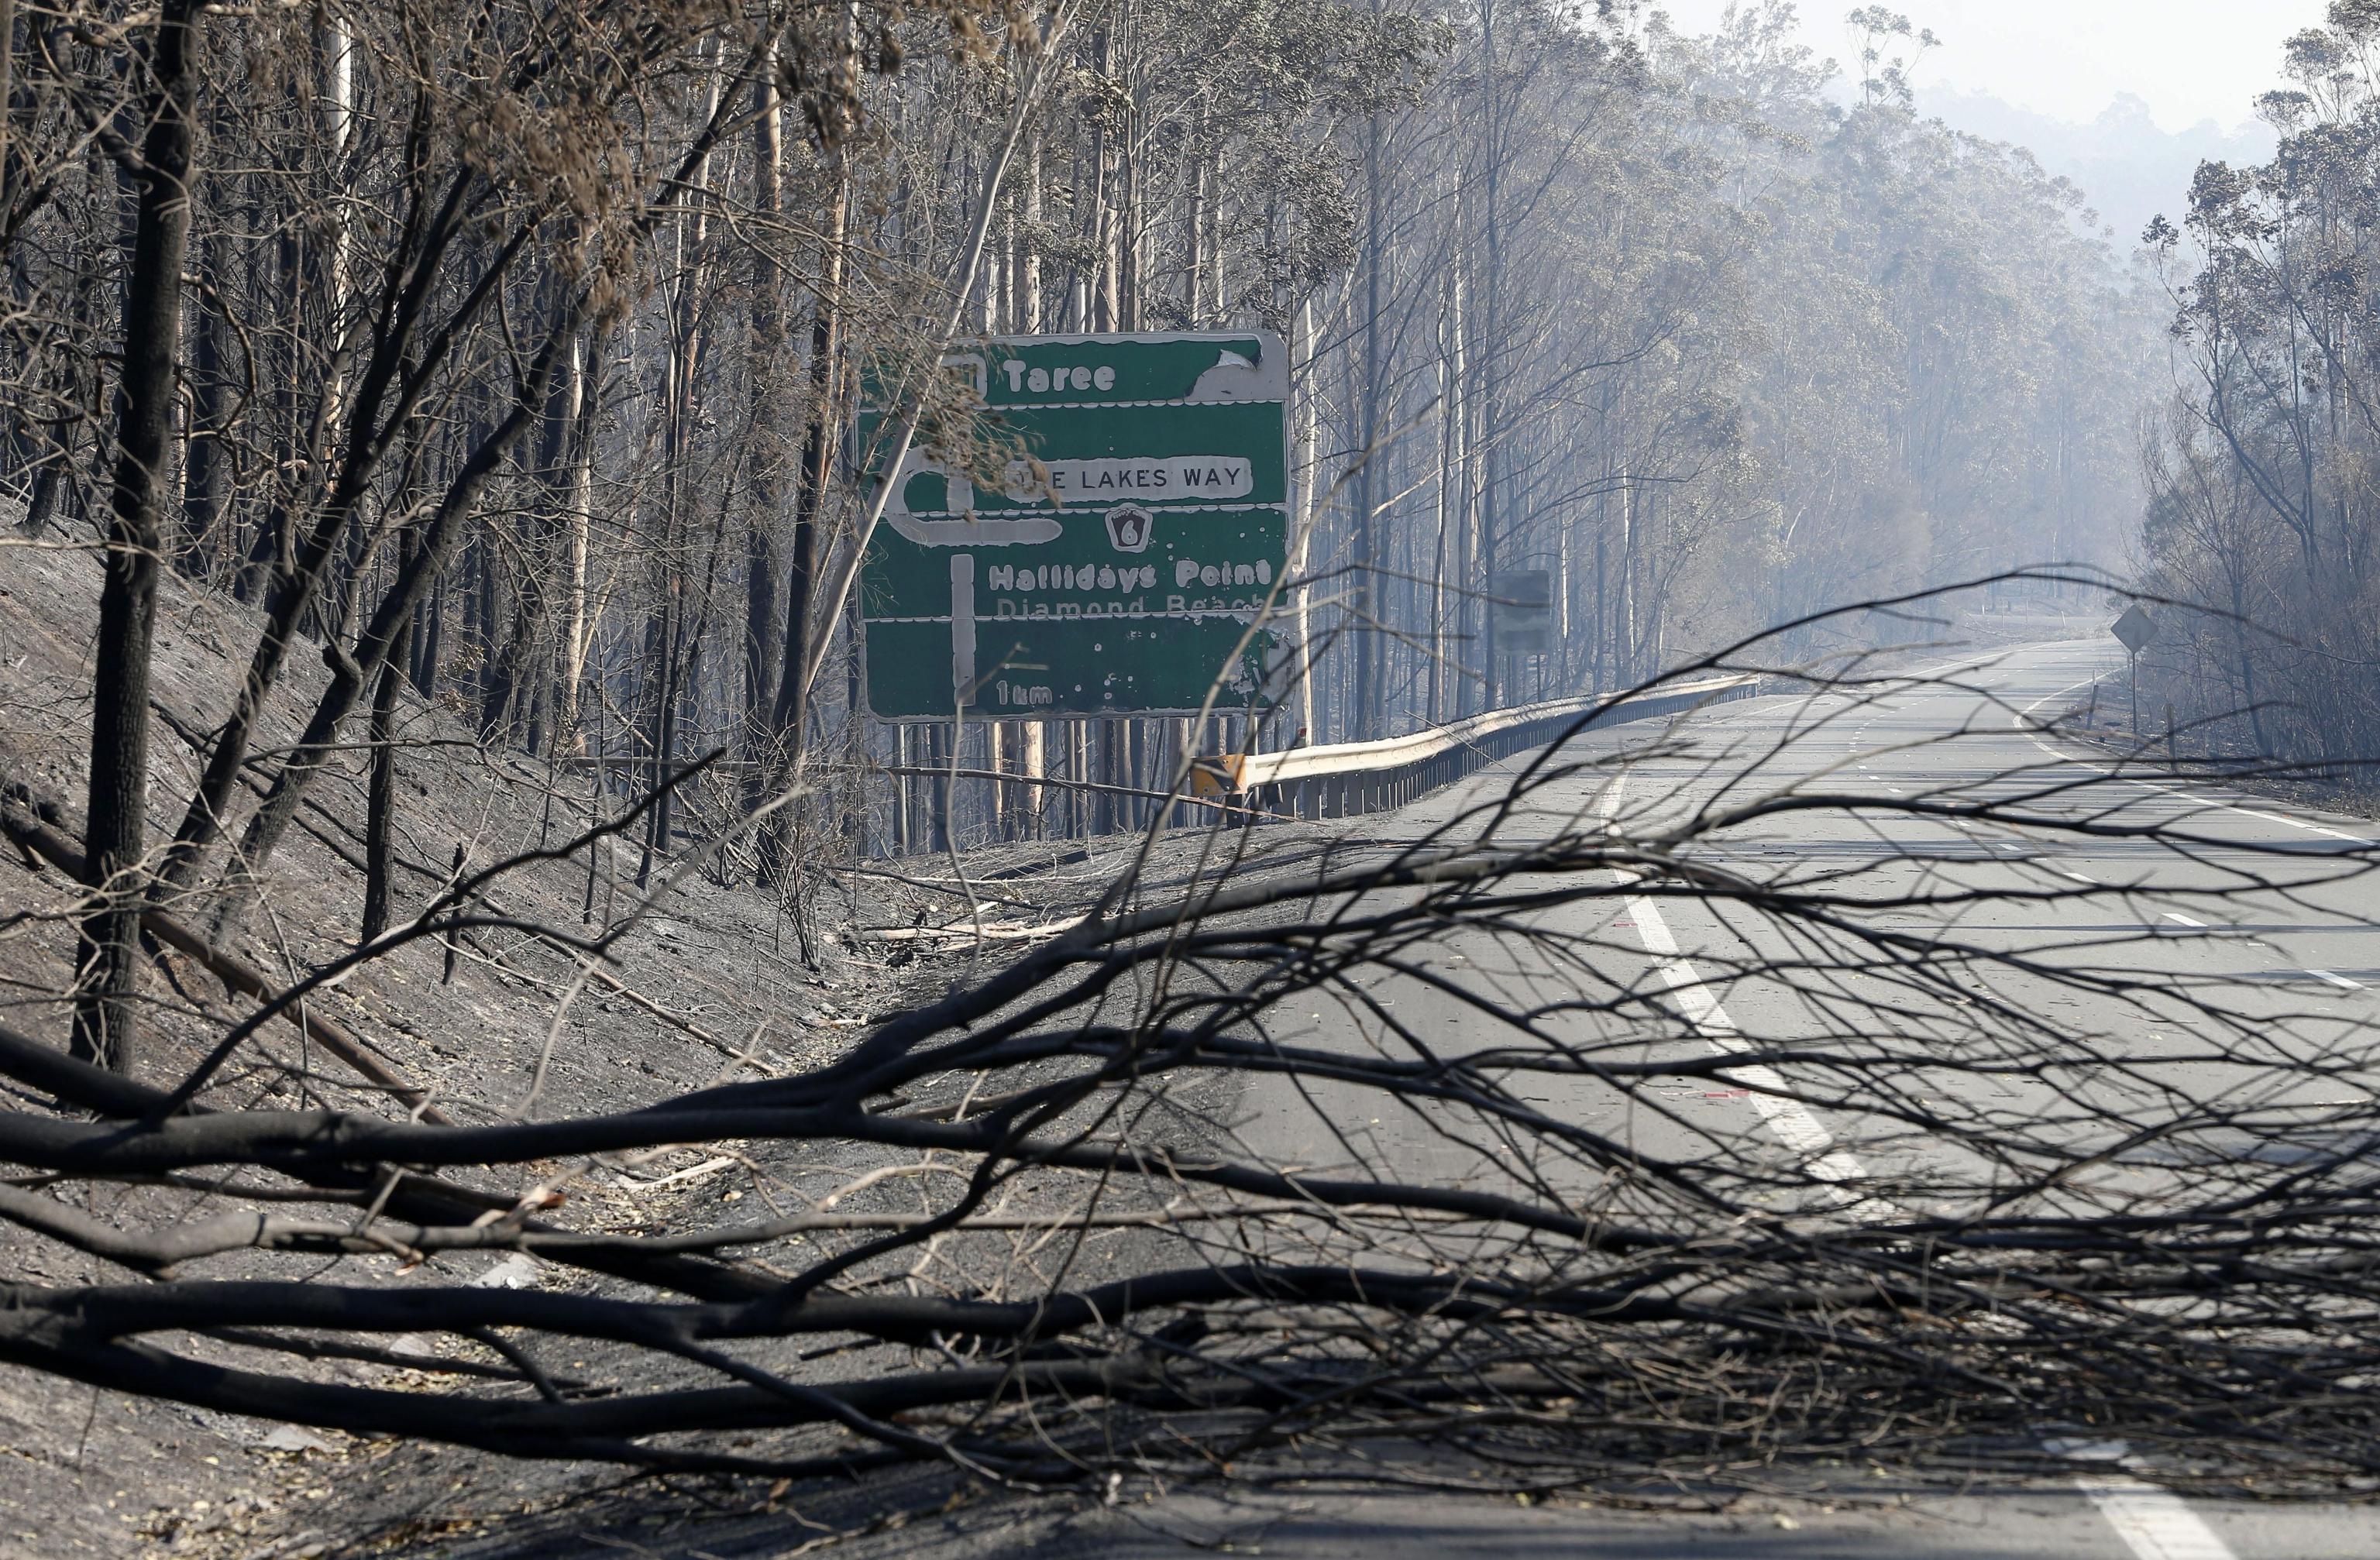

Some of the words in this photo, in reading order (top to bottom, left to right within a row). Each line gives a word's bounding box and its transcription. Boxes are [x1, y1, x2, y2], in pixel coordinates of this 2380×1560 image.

[1003, 359, 1116, 393] Taree
[1082, 469, 1168, 489] LAKES
[1184, 467, 1241, 487] WAY
[989, 563, 1157, 594] Hallidays
[1175, 558, 1272, 588] Point
[997, 595, 1144, 617] Diamond
[996, 680, 1008, 706] 1
